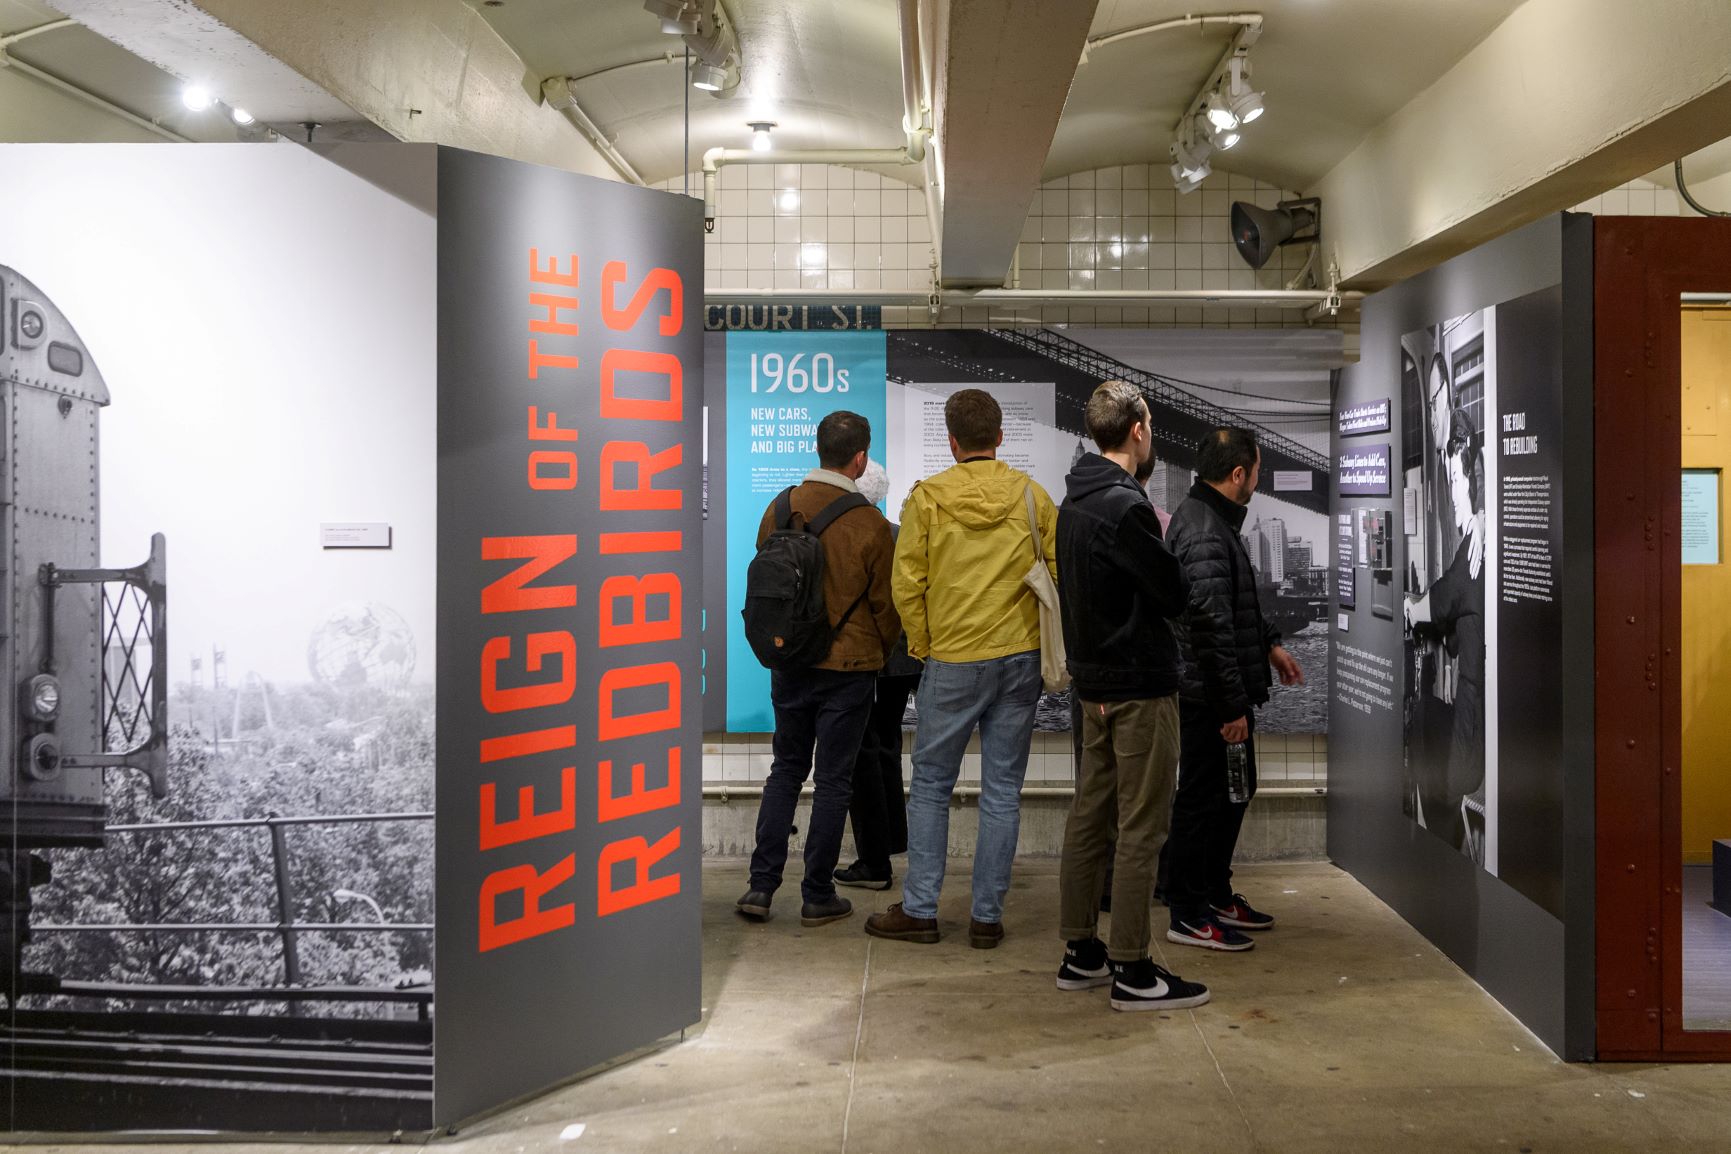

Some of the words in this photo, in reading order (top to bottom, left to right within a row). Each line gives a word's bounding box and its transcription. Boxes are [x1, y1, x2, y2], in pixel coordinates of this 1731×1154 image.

[528, 247, 580, 380] THE
[751, 352, 850, 394] 1960s
[751, 407, 775, 421] NEW
[778, 407, 812, 422] CARS,
[1503, 413, 1512, 432] THE
[1512, 412, 1525, 431] ROAD
[751, 424, 775, 437] NEW
[778, 424, 819, 437] SUBWA
[1503, 437, 1510, 455] TO
[1510, 435, 1538, 455] REBUILDING
[528, 406, 579, 491] OF
[751, 440, 773, 454] AND
[776, 440, 795, 454] BIG
[598, 259, 684, 918] REDBIRDS
[478, 533, 578, 953] REIGN
